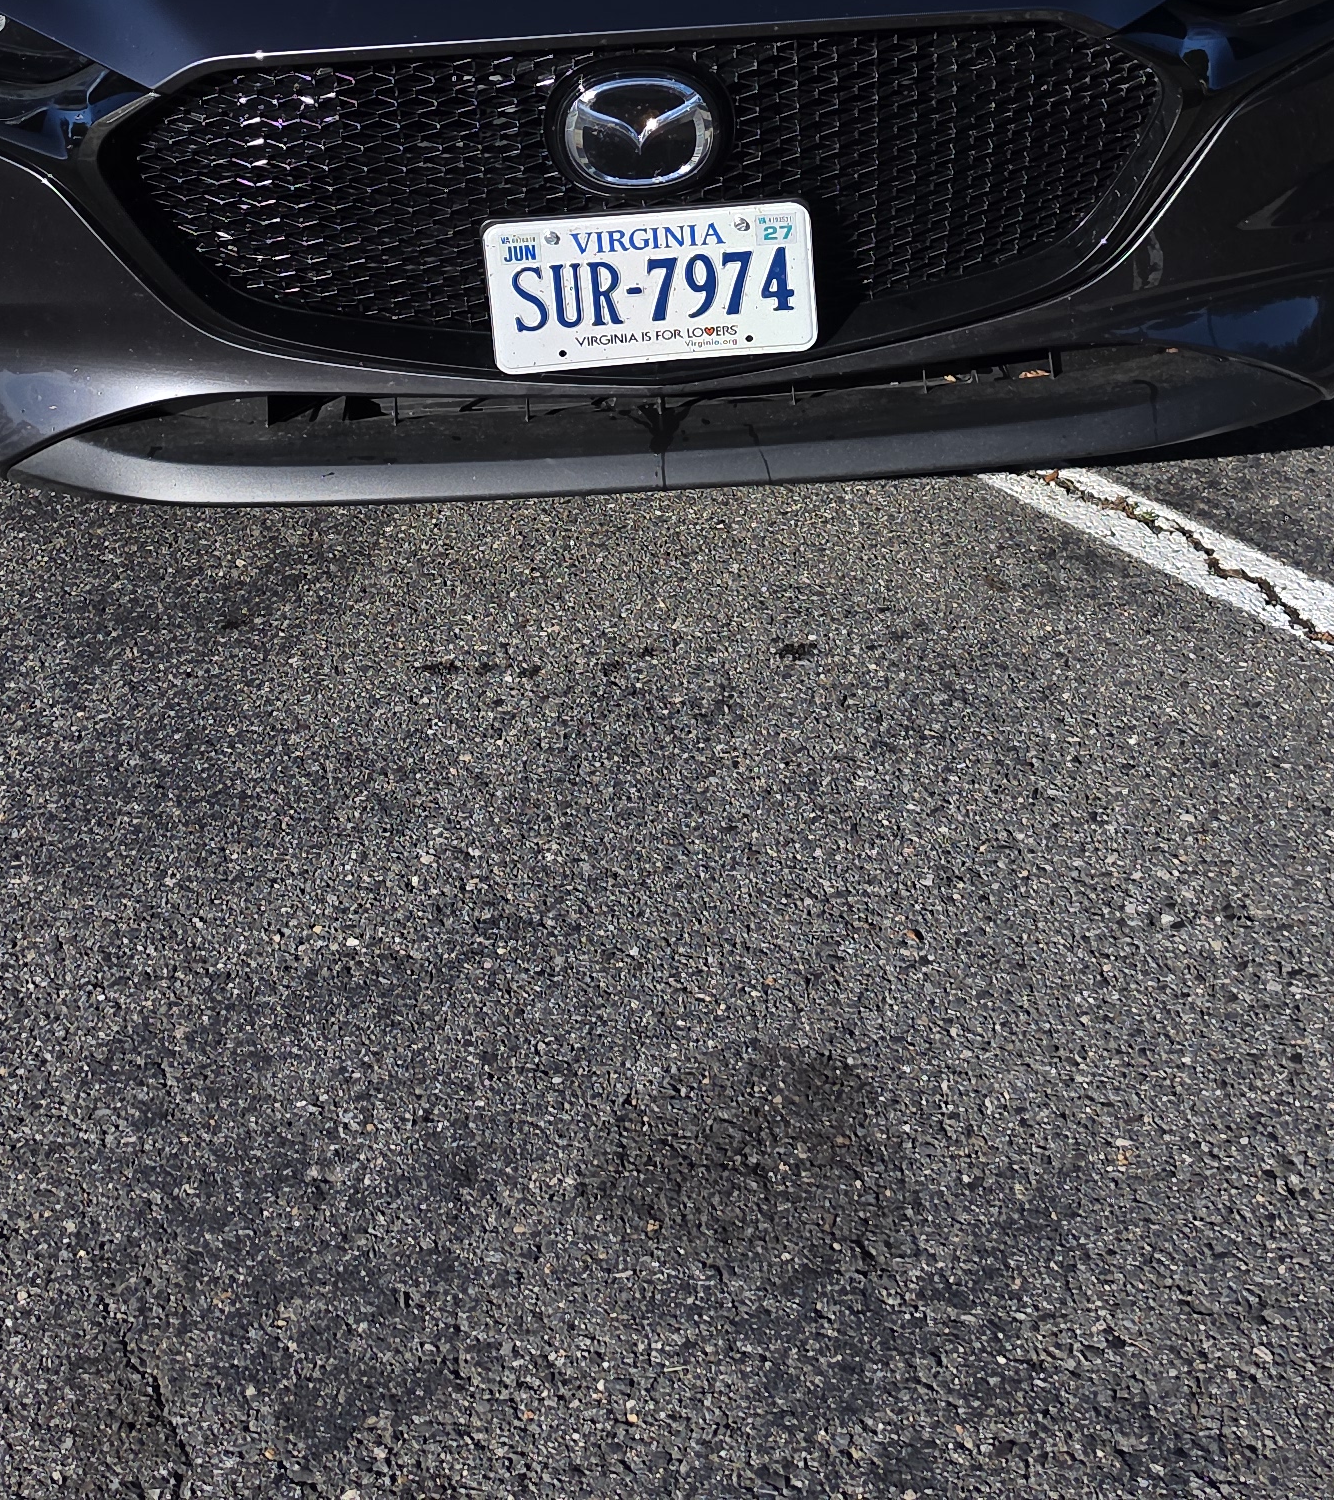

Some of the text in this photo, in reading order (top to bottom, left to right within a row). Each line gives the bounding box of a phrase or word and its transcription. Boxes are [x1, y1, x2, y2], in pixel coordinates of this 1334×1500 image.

[568, 221, 727, 256] VIRGINIA
[763, 225, 793, 241] 27
[503, 244, 537, 263] JUN
[511, 246, 795, 333] SUR-7974
[574, 333, 639, 348] VIRGINIA
[641, 331, 653, 343] IS
[655, 329, 684, 342] FOR
